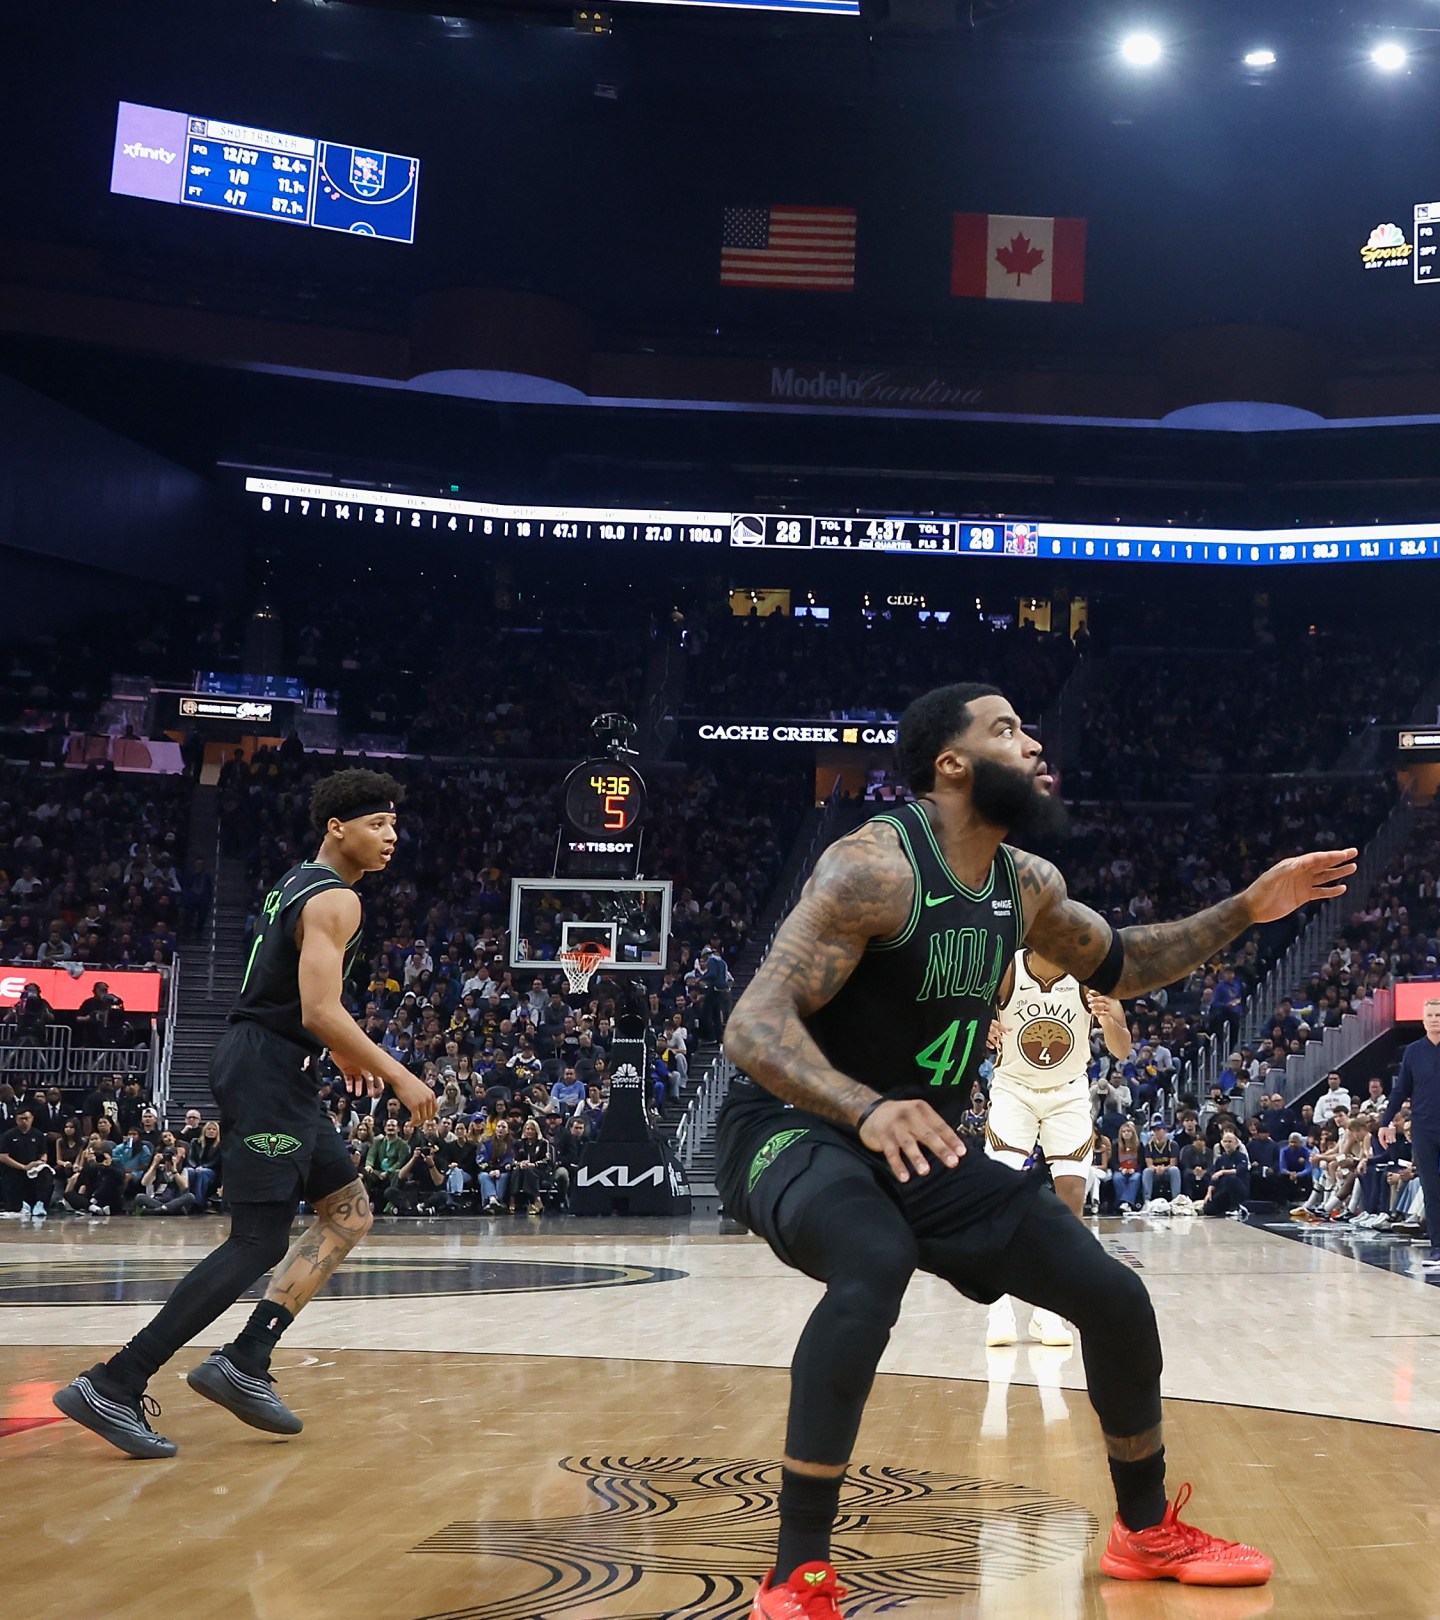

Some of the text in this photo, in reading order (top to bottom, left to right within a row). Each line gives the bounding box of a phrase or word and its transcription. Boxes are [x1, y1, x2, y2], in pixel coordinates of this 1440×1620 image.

[220, 126, 247, 139] SHOT
[122, 142, 177, 165] xfinity
[193, 145, 208, 155] FG
[223, 147, 258, 164] 12/37
[189, 186, 202, 196] FT
[224, 189, 246, 205] 4/7
[1360, 243, 1414, 263] Sports
[1365, 258, 1409, 269] BAY AREA
[771, 367, 982, 404] Modelo Cantina
[301, 500, 310, 515] 7
[336, 504, 350, 519] 14
[374, 508, 384, 523] 2
[411, 512, 421, 527] 2
[448, 516, 458, 531] 4
[553, 523, 578, 538] 47.1
[645, 526, 672, 541] 27.0
[689, 528, 722, 543] 100.0
[820, 520, 841, 531] TOL
[866, 520, 905, 540] 4:37
[918, 523, 940, 534] TOL
[775, 521, 801, 543] 28
[969, 526, 995, 550] 29
[820, 535, 839, 546] FLS
[844, 535, 852, 547] 4
[875, 540, 912, 550] QUARTER
[918, 539, 938, 549] FLS
[1151, 543, 1162, 558] 4
[1185, 544, 1193, 559] 1
[1359, 542, 1380, 557] 11.1
[699, 725, 769, 741] CACHE
[772, 727, 838, 742] CREEK
[590, 776, 630, 795] 4:36
[604, 796, 626, 828] 5
[916, 928, 1004, 1006] NOLA
[1014, 1001, 1077, 1024] TOWN
[915, 1019, 978, 1086] 41
[1039, 1047, 1051, 1064] 4
